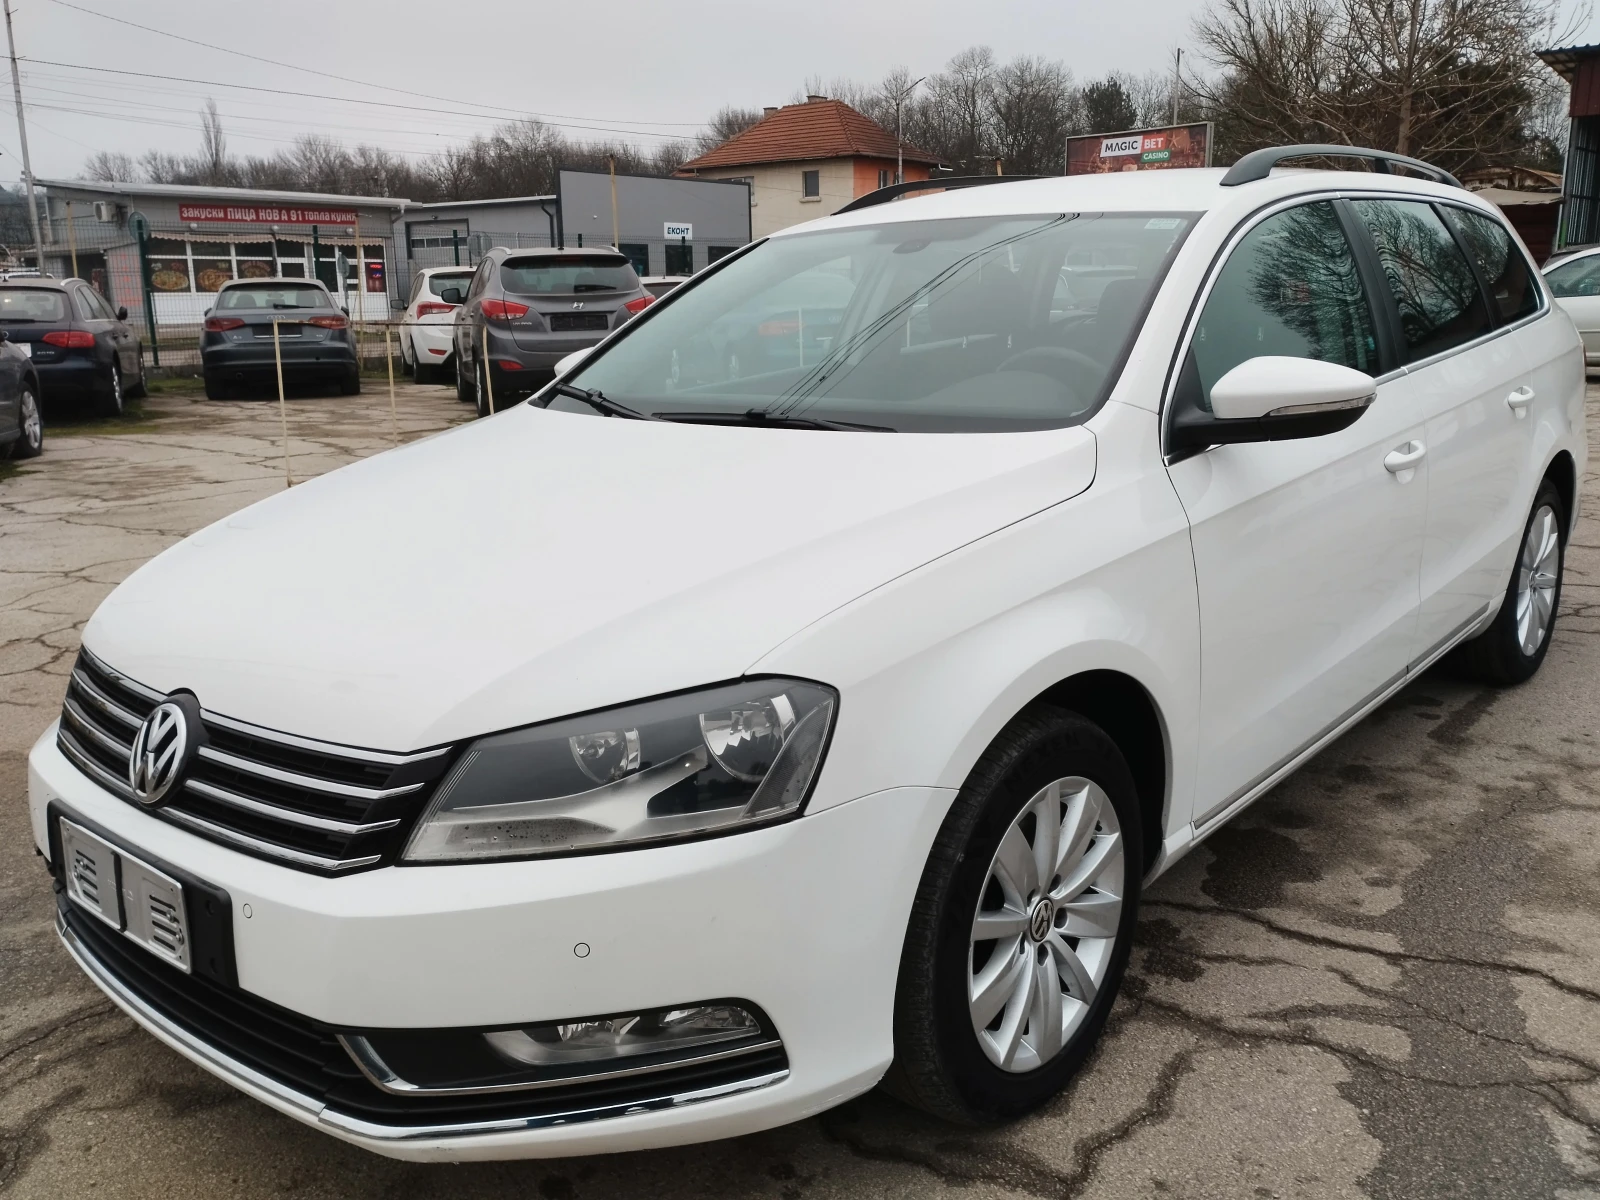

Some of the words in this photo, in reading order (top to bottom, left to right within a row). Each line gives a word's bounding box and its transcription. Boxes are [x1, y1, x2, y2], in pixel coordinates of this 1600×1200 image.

[1104, 140, 1138, 152] MAGIC
[1144, 137, 1164, 149] BET
[1143, 151, 1169, 160] CASINO
[227, 208, 256, 221] ПИЦА
[290, 210, 302, 221] 91
[667, 226, 689, 235] ЕКОНТ
